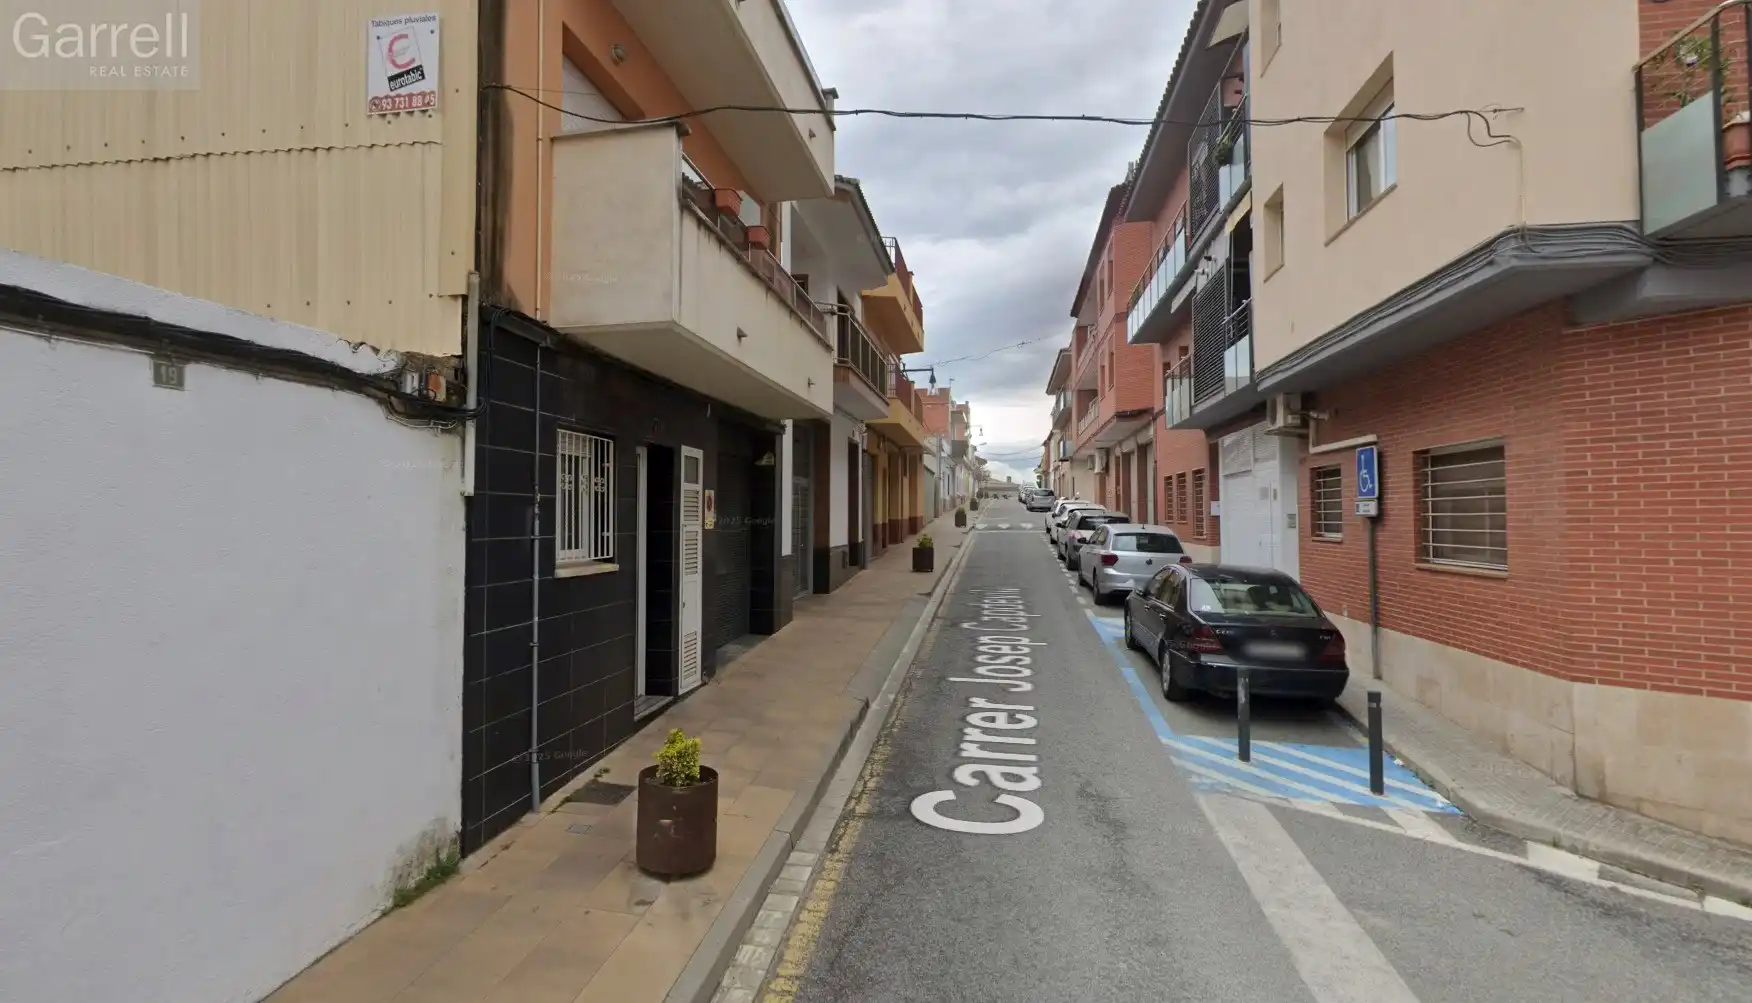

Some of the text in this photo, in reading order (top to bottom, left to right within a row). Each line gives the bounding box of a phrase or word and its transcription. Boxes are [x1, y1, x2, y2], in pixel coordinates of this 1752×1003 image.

[371, 14, 437, 28] Tabiques pluviales
[389, 70, 423, 90] eurotabic
[381, 98, 392, 110] 93
[395, 96, 409, 109] 731
